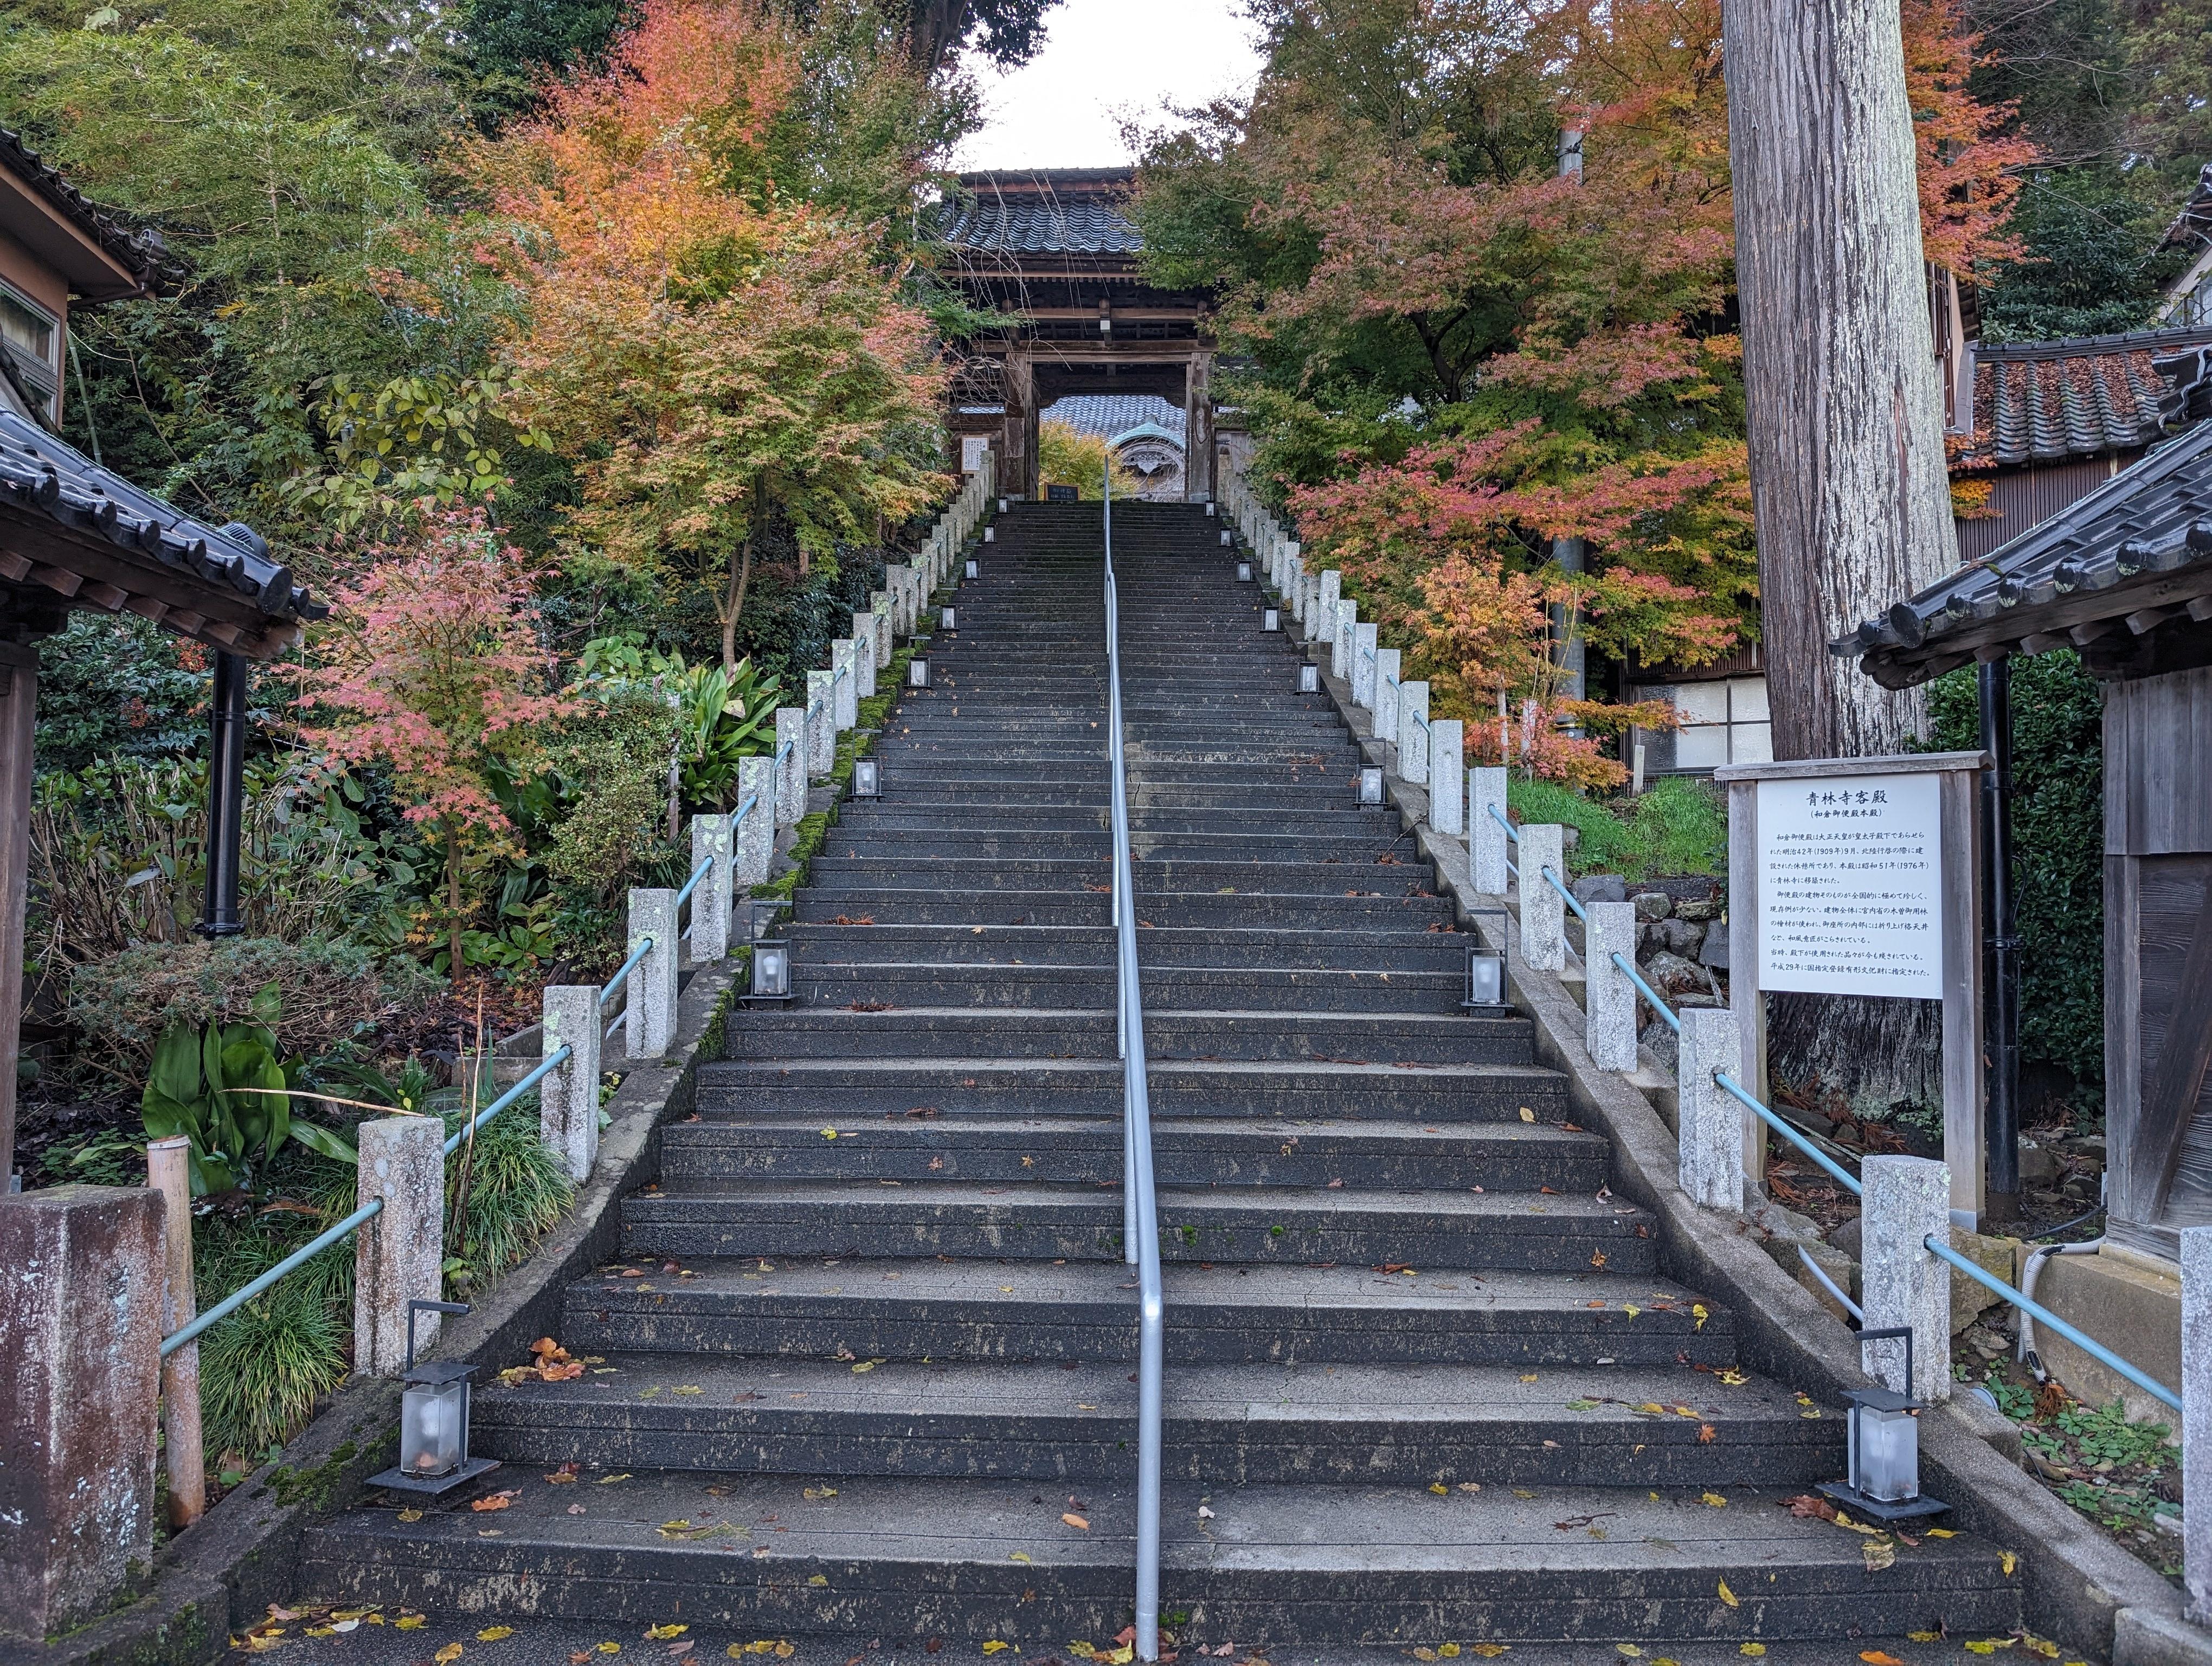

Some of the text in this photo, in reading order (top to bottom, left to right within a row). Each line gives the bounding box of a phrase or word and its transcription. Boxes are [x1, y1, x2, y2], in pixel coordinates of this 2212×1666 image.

[1805, 790, 1888, 807] 青林寺客殿
[1811, 808, 1882, 819] (和倉御便殿本殿)
[1776, 831, 1925, 842] 和倉御便殿は大正天皇が皇太子殿下であらせら
[1770, 876, 1840, 885] に青林寺に移築された。
[1771, 934, 1870, 944] など、和風意匠がこらされている。
